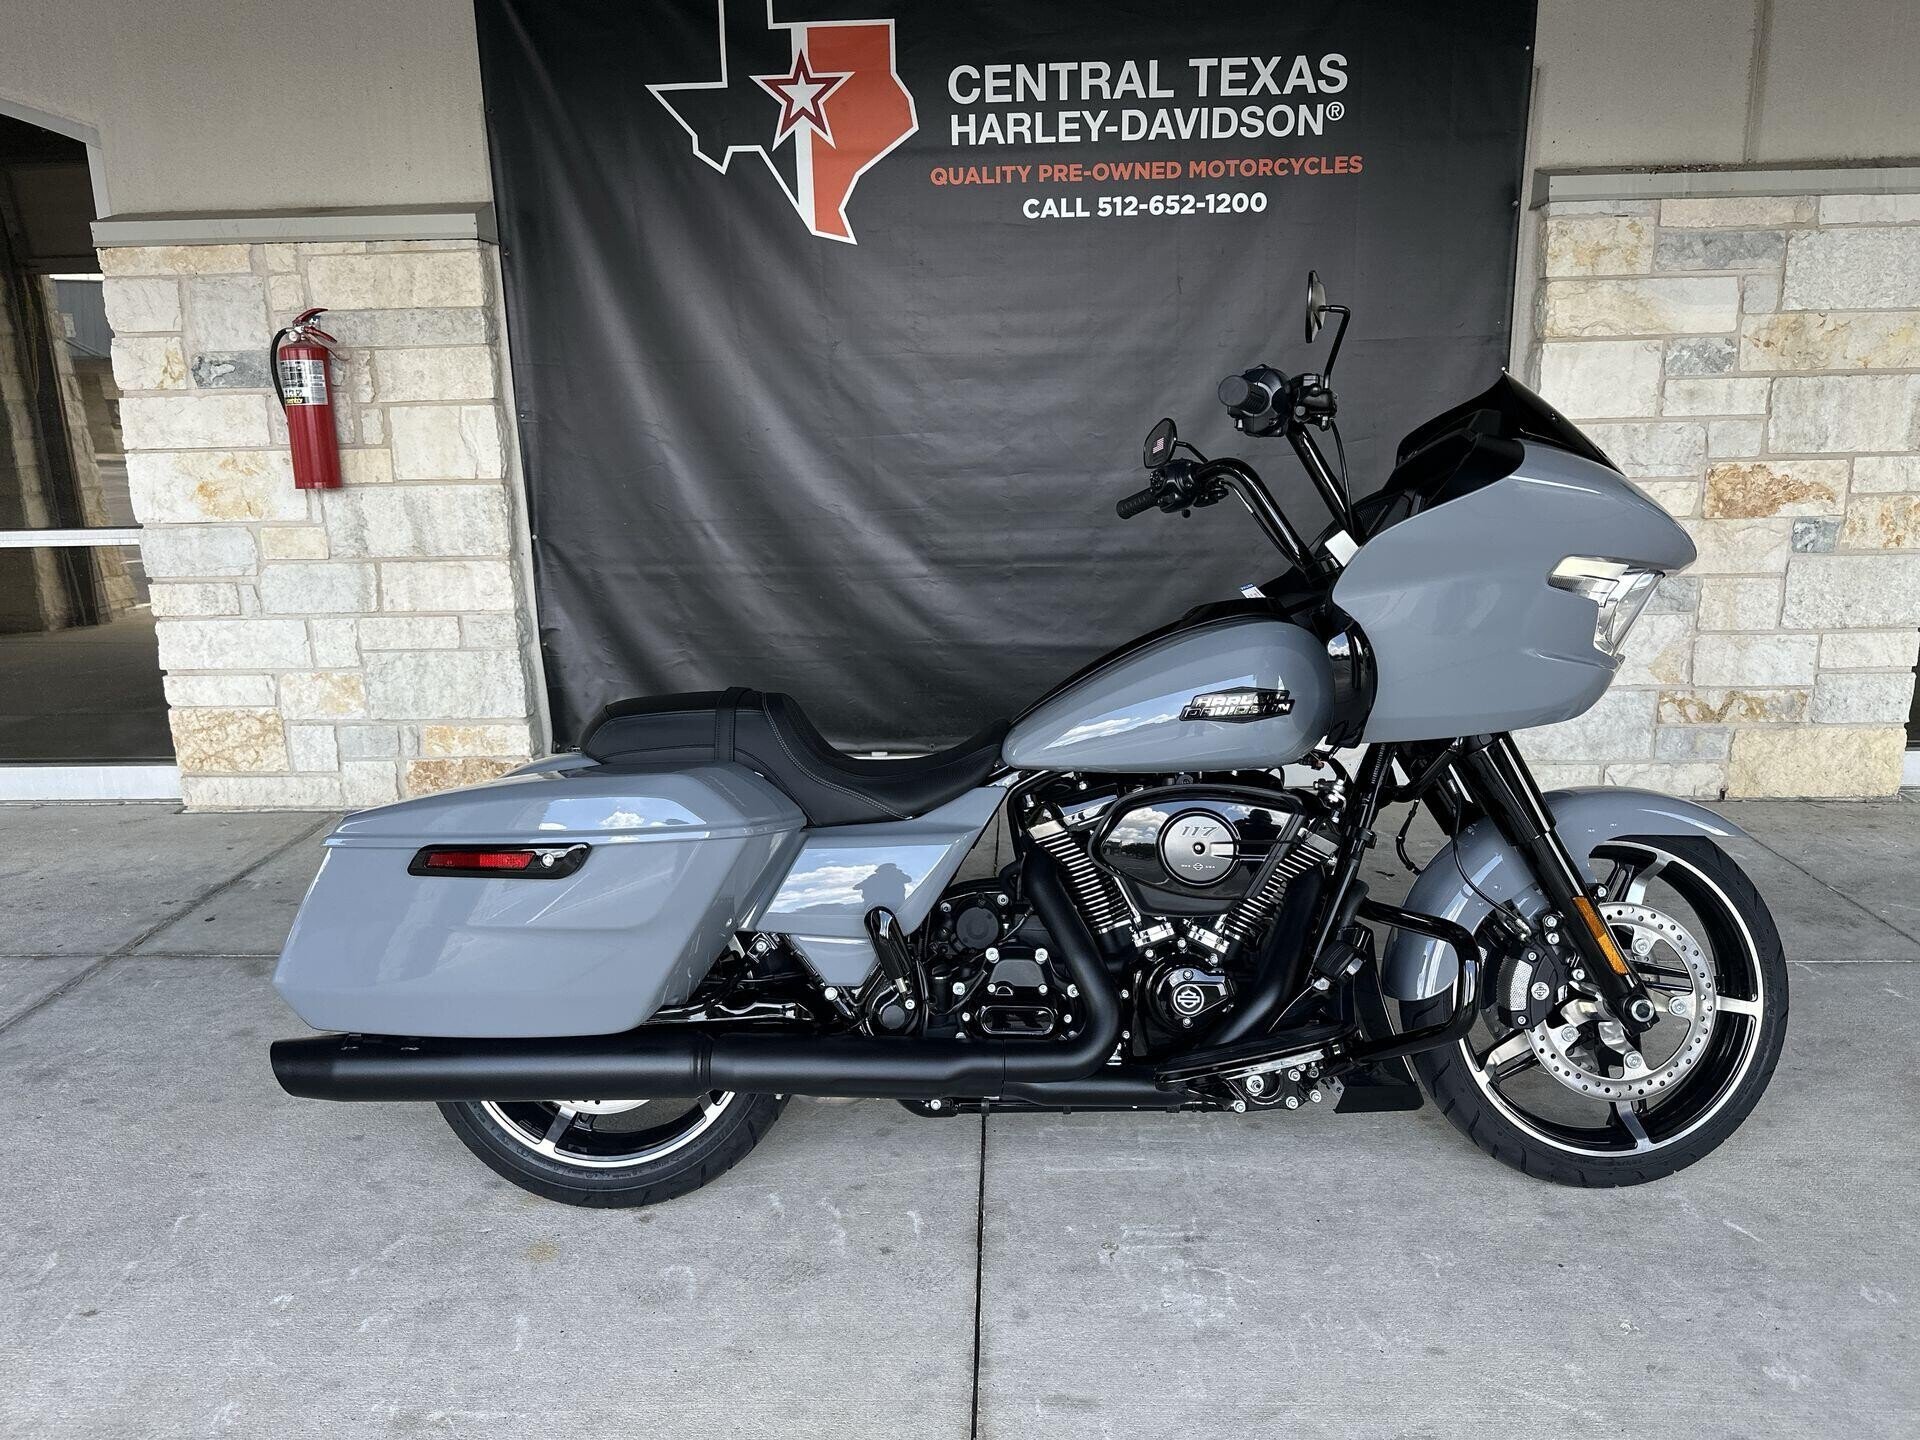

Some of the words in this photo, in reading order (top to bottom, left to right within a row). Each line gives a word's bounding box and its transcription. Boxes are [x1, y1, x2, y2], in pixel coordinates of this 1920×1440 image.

[947, 60, 1175, 105] CENTRAL
[1188, 53, 1348, 98] TEXAS
[930, 164, 1032, 186] QUALITY
[1038, 160, 1182, 183] PRE-OWNED
[1188, 155, 1363, 179] MOTORCYCLES
[1022, 197, 1090, 220] CALL
[1096, 192, 1268, 218] 512-652-1200
[1181, 826, 1218, 836] 117
